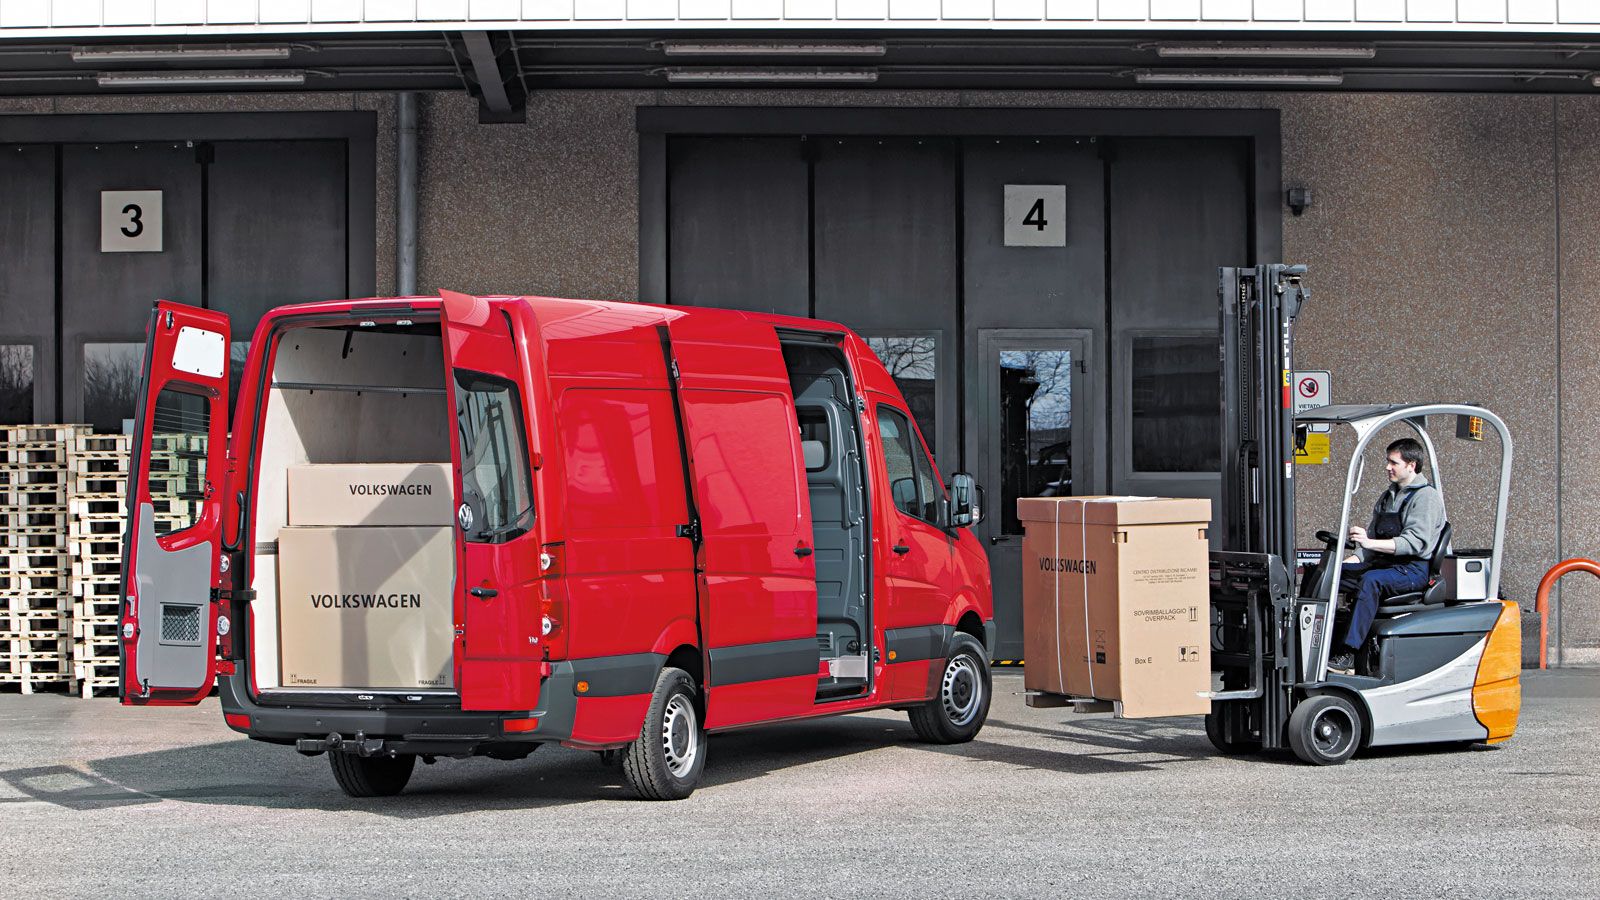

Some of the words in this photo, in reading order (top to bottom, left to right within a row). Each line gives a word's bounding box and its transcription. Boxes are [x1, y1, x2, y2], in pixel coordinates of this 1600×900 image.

[120, 203, 143, 237] 3
[1022, 198, 1047, 231] 4
[349, 484, 432, 496] VOLKSWAGEN
[311, 594, 421, 608] VOLKSWAGEN
[1133, 608, 1187, 616] SOVRIMBALLAGGIO
[1134, 657, 1146, 665] Box
[1147, 656, 1153, 664] E
